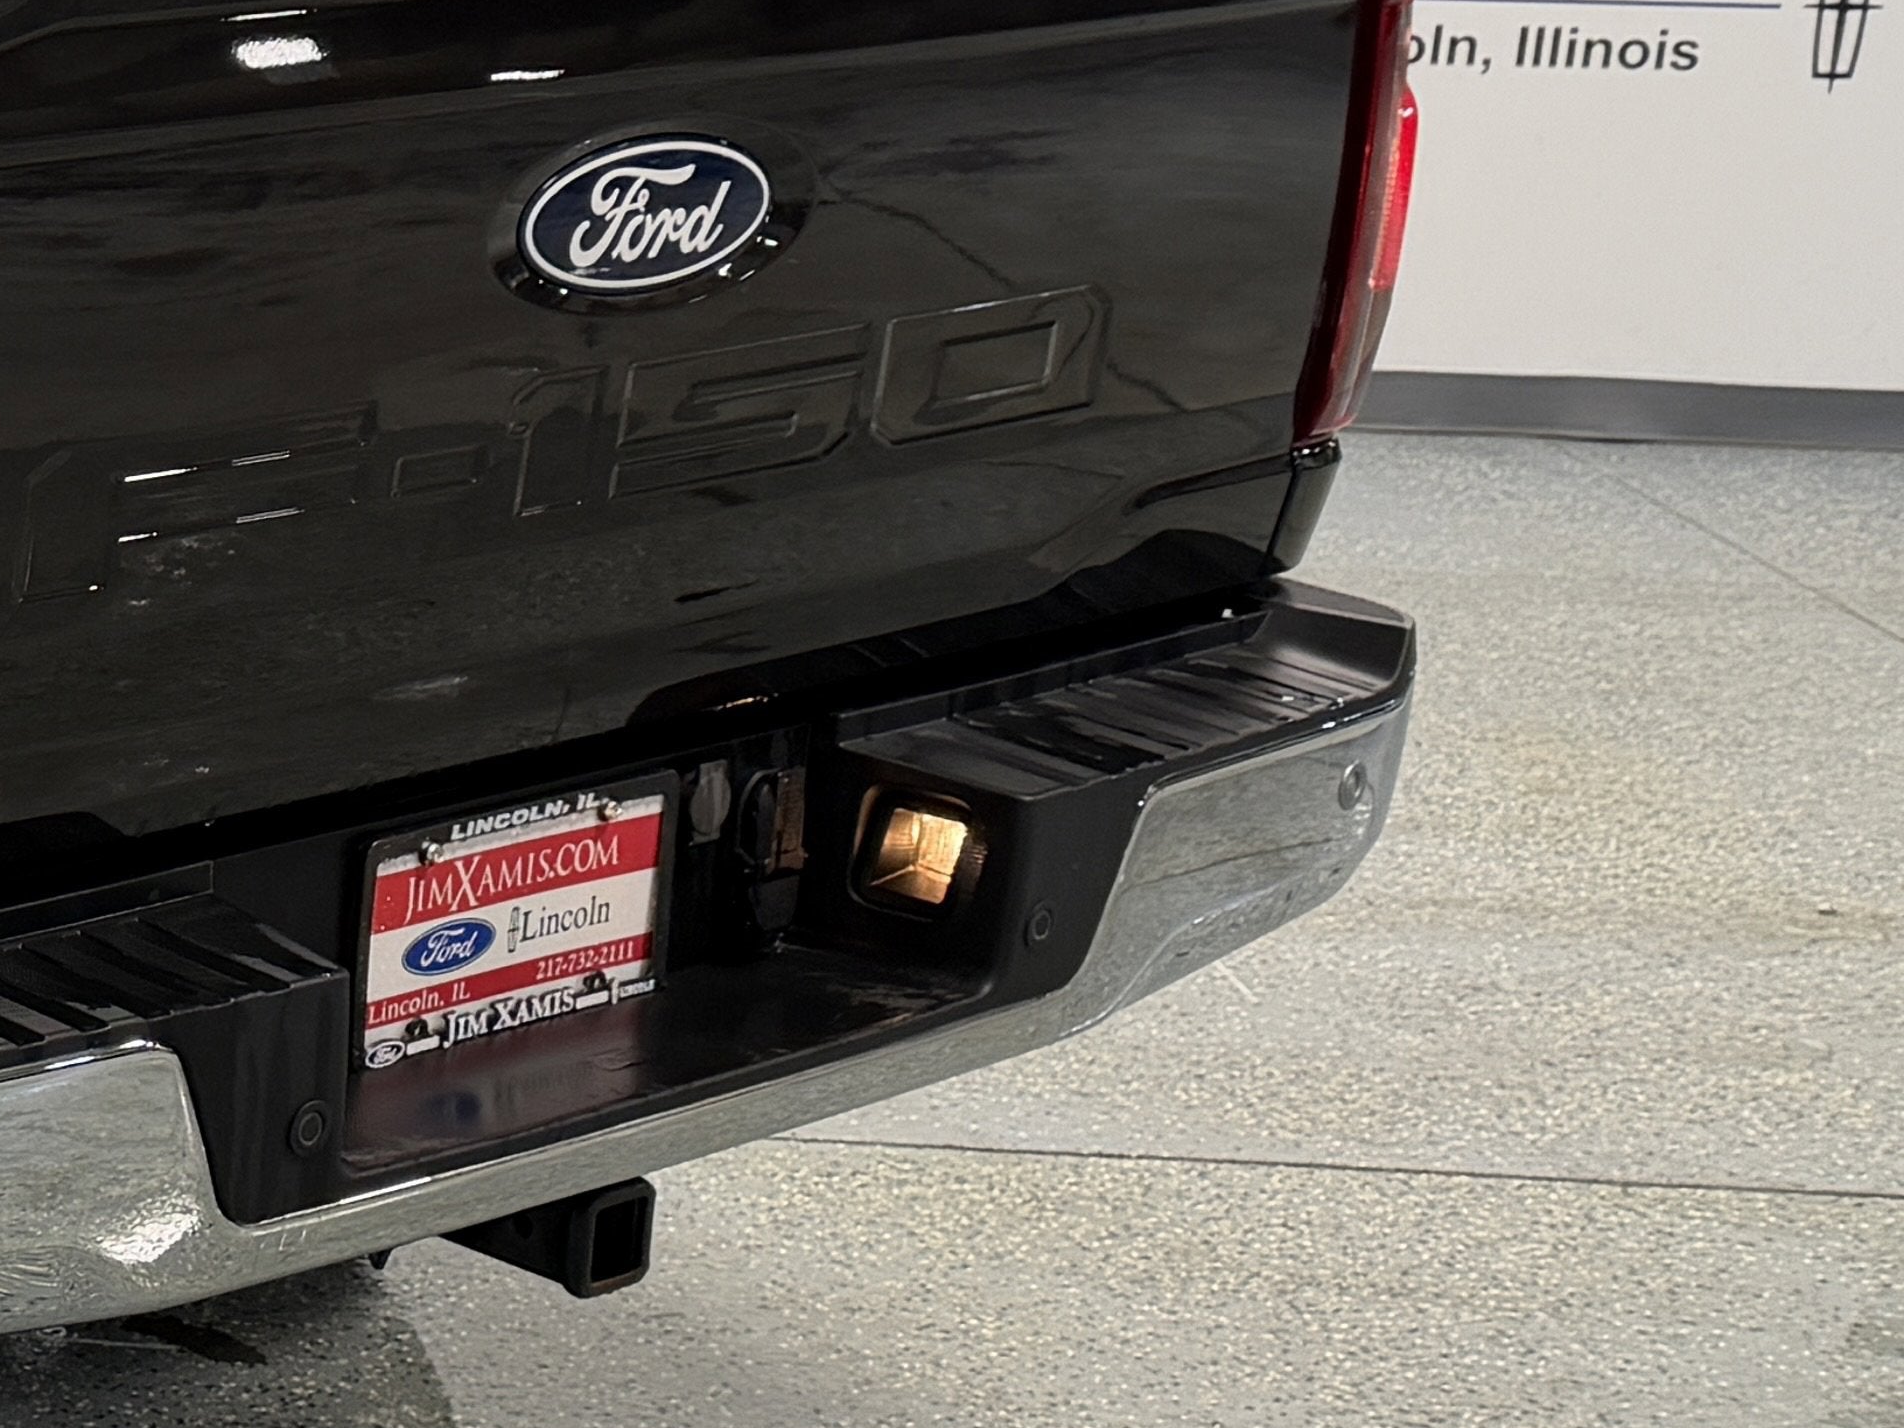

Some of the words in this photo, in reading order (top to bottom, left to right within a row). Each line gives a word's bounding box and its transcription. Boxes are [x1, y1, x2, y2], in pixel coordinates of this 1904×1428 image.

[1515, 25, 1700, 72] Illinois
[570, 162, 733, 266] Ford
[451, 799, 571, 841] LINCOLN,
[519, 895, 611, 943] Lincoln
[420, 926, 474, 967] Ford
[535, 941, 635, 980] 217-732-2111
[451, 981, 472, 1001] IL
